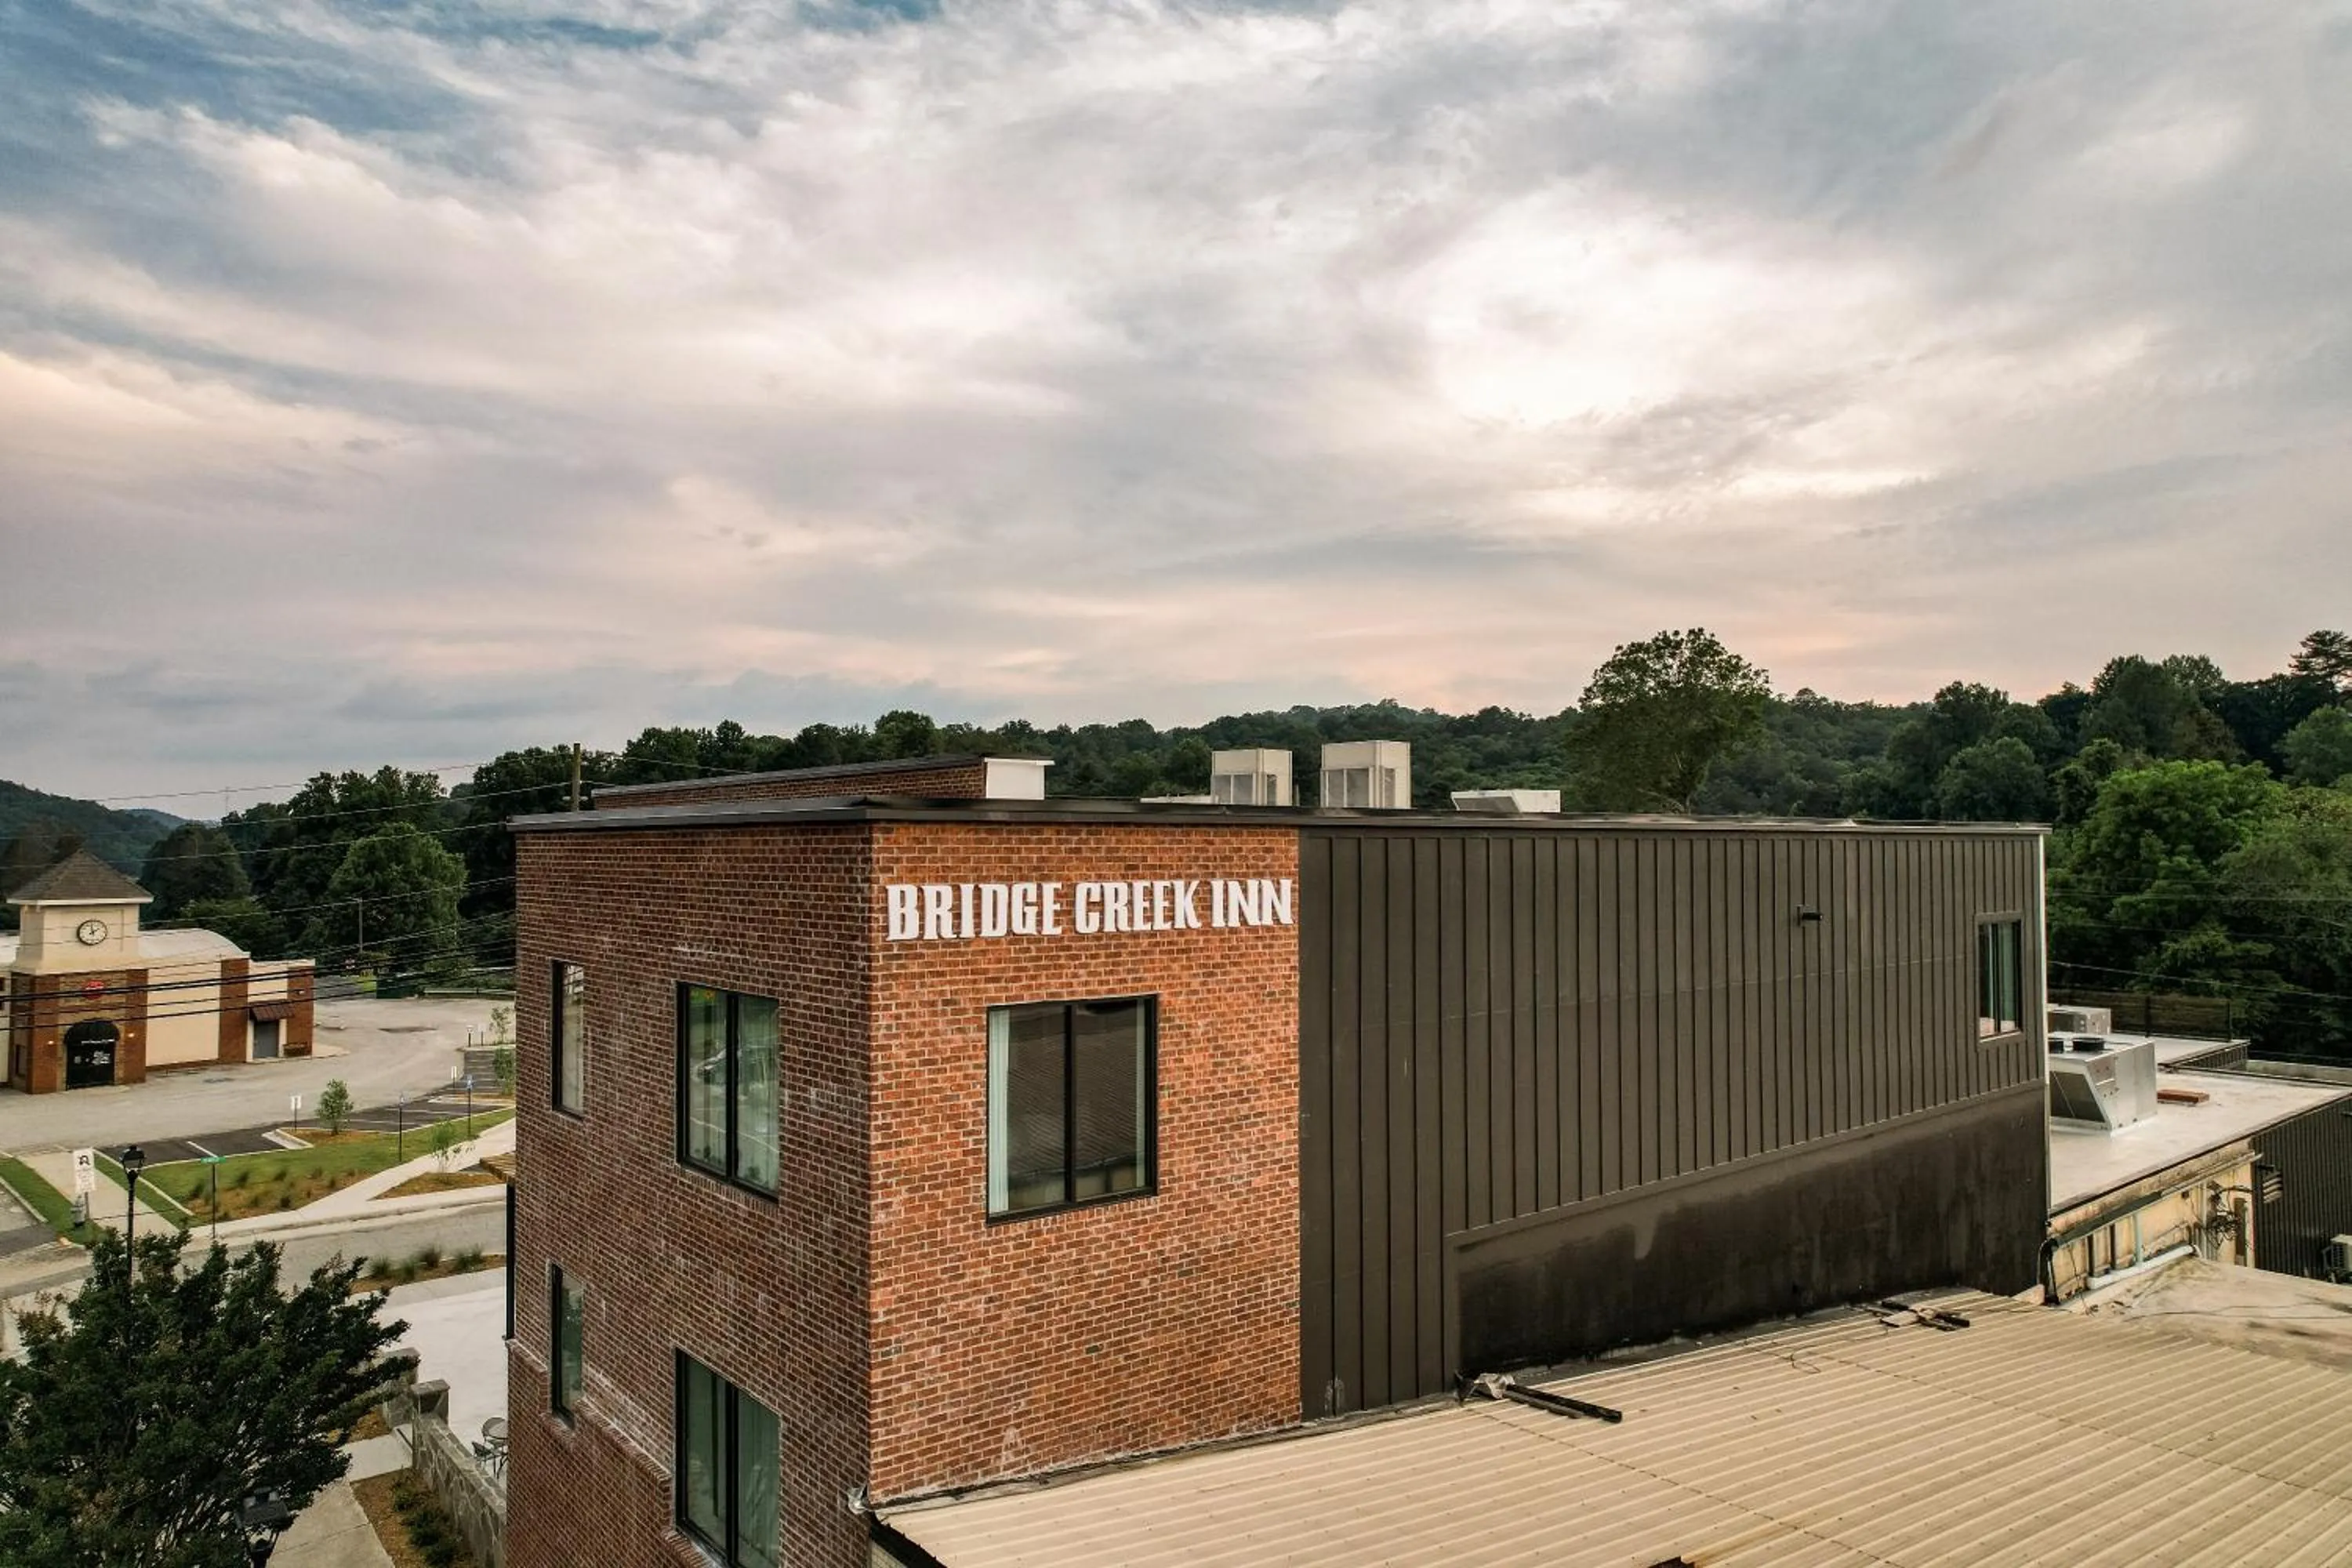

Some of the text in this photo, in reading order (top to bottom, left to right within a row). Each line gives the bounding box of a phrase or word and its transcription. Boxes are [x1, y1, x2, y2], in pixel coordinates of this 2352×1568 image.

[886, 879, 1294, 941] BRIDGE CREEK INN
